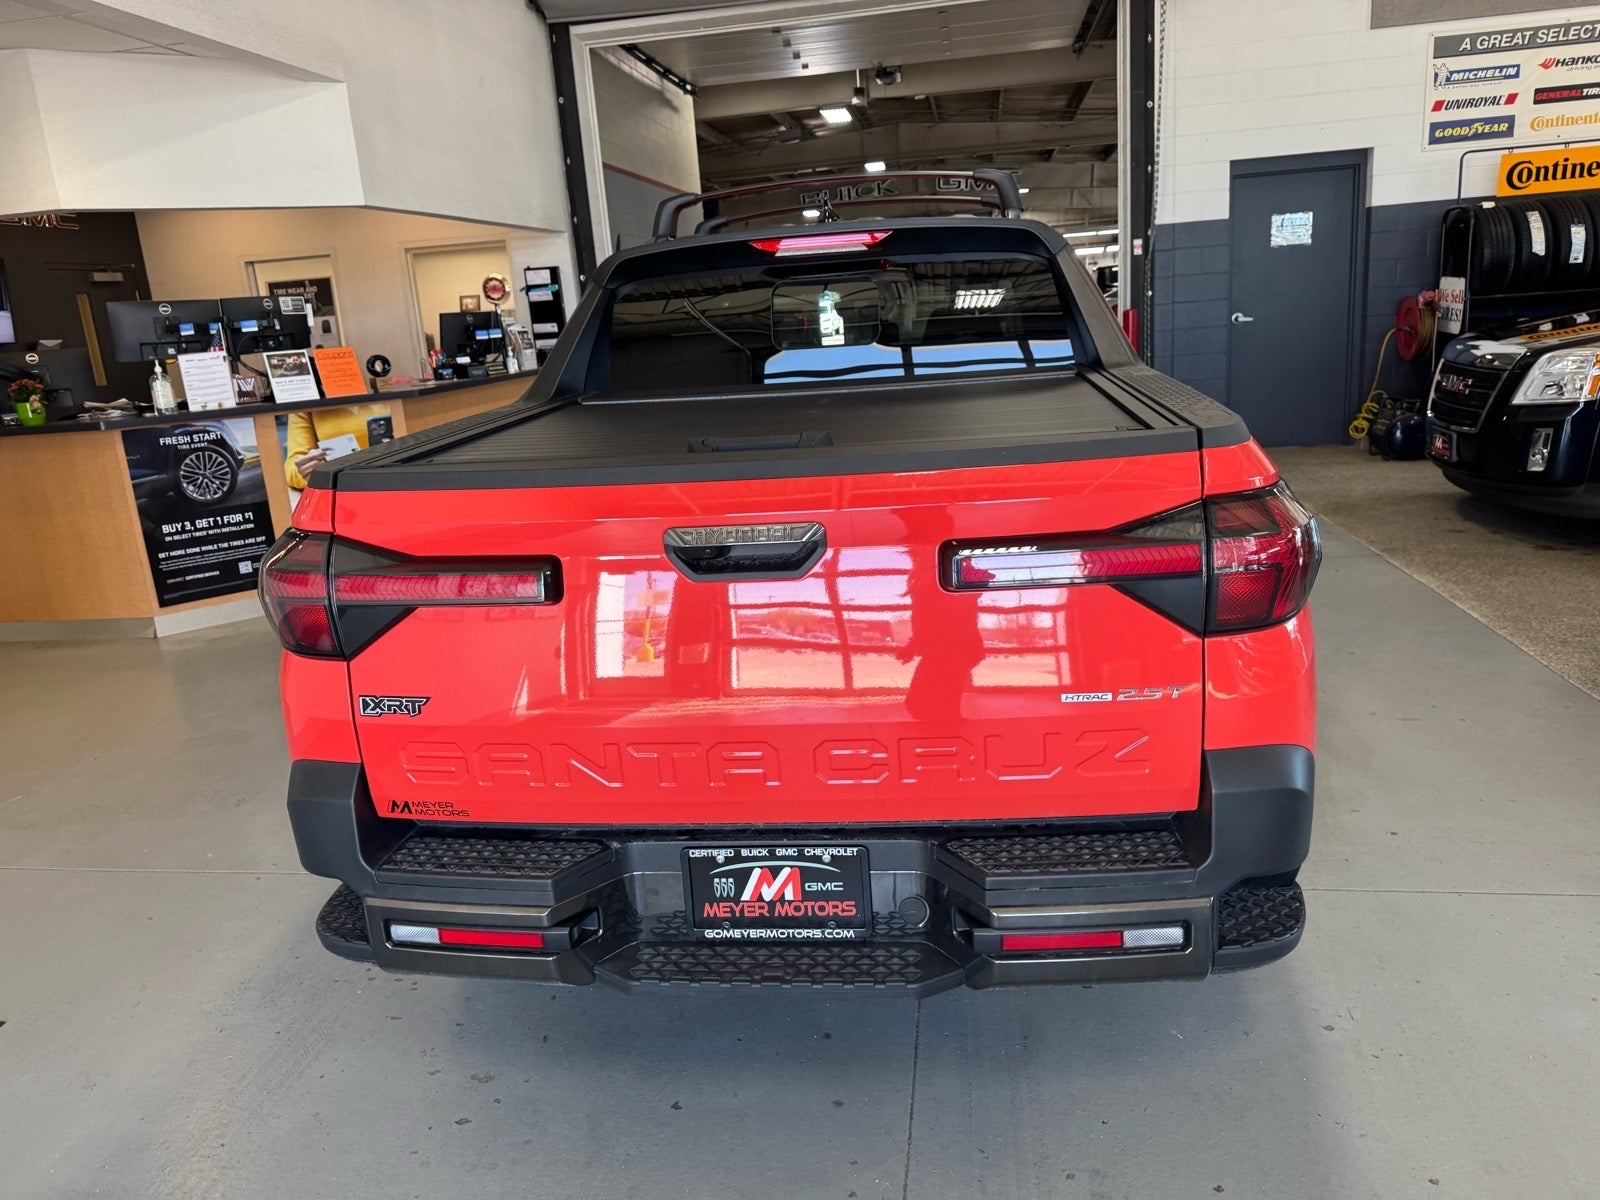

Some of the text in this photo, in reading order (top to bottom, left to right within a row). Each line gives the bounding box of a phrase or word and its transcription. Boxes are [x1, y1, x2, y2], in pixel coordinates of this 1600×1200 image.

[1459, 39, 1472, 52] A
[1476, 31, 1534, 50] GREAT
[1450, 67, 1518, 81] MICHELIN
[1535, 88, 1600, 100] GENERAL TIR
[1444, 95, 1503, 111] UNIROYAL
[1434, 122, 1509, 138] GOODYEAR
[1529, 112, 1600, 132] Continent
[799, 178, 899, 206] BUICK
[287, 286, 304, 295] WEAR
[305, 285, 318, 293] AND
[1451, 288, 1464, 304] Sell
[159, 431, 222, 446] FRESH START
[162, 511, 254, 534] BUY 3, GET 1 FOR $1
[221, 523, 255, 533] INSTALLATION
[692, 525, 792, 545] HYUNDAI
[170, 549, 186, 557] MORE
[201, 544, 218, 552] WHILE
[218, 541, 229, 549] THE
[229, 538, 245, 547] TIRES
[359, 695, 431, 717] XRT
[401, 728, 1150, 787] SANTA CRUZ
[412, 801, 454, 810] MEYER
[415, 808, 470, 817] MOTORS
[689, 848, 858, 858] CERTIFIED BUICK GMC CHEVROLET
[804, 882, 844, 891] GMC
[703, 901, 856, 918] MEYER MOTORS
[704, 929, 855, 939] GOMEYERMOTORS.COM
